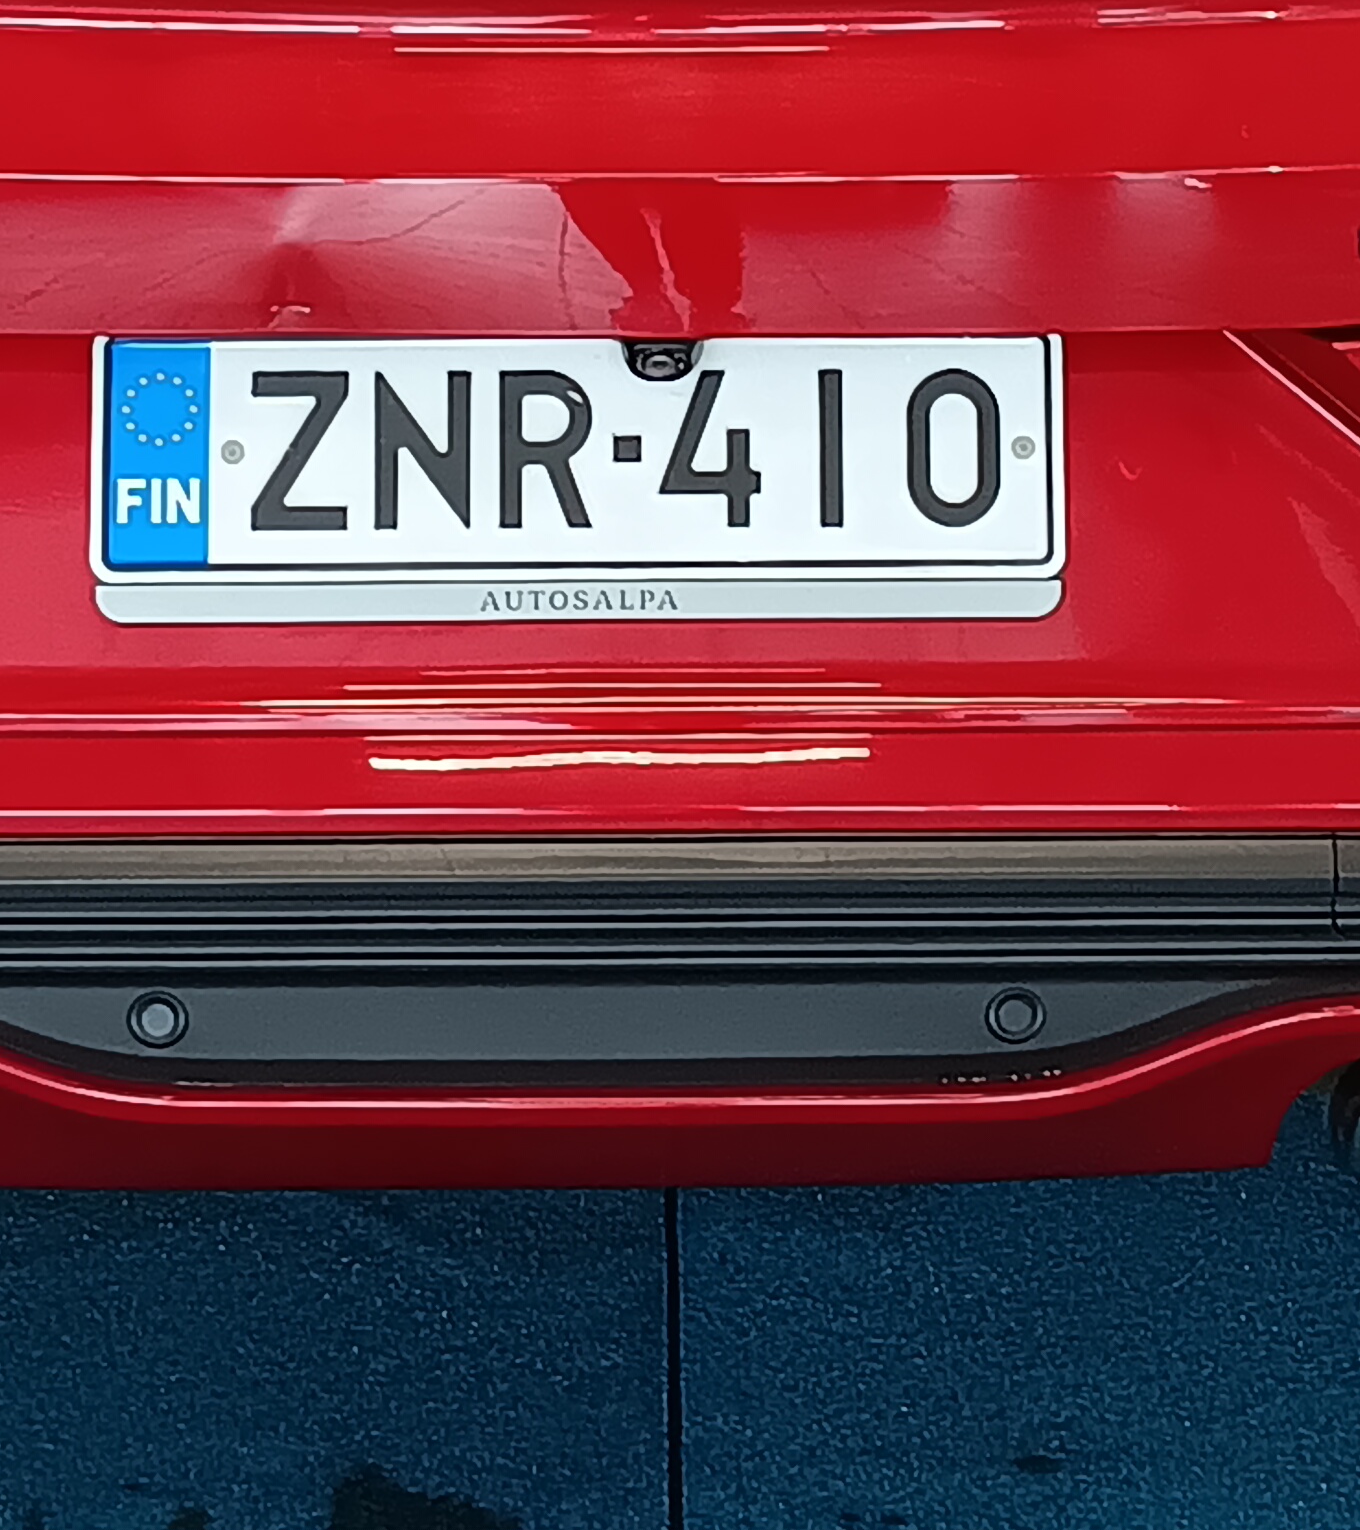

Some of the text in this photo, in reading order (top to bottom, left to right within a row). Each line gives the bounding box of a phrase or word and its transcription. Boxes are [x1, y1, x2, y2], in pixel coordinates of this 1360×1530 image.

[249, 367, 1003, 532] ZNR-410
[114, 476, 202, 525] FIN
[480, 589, 679, 612] AUTOSALPA
